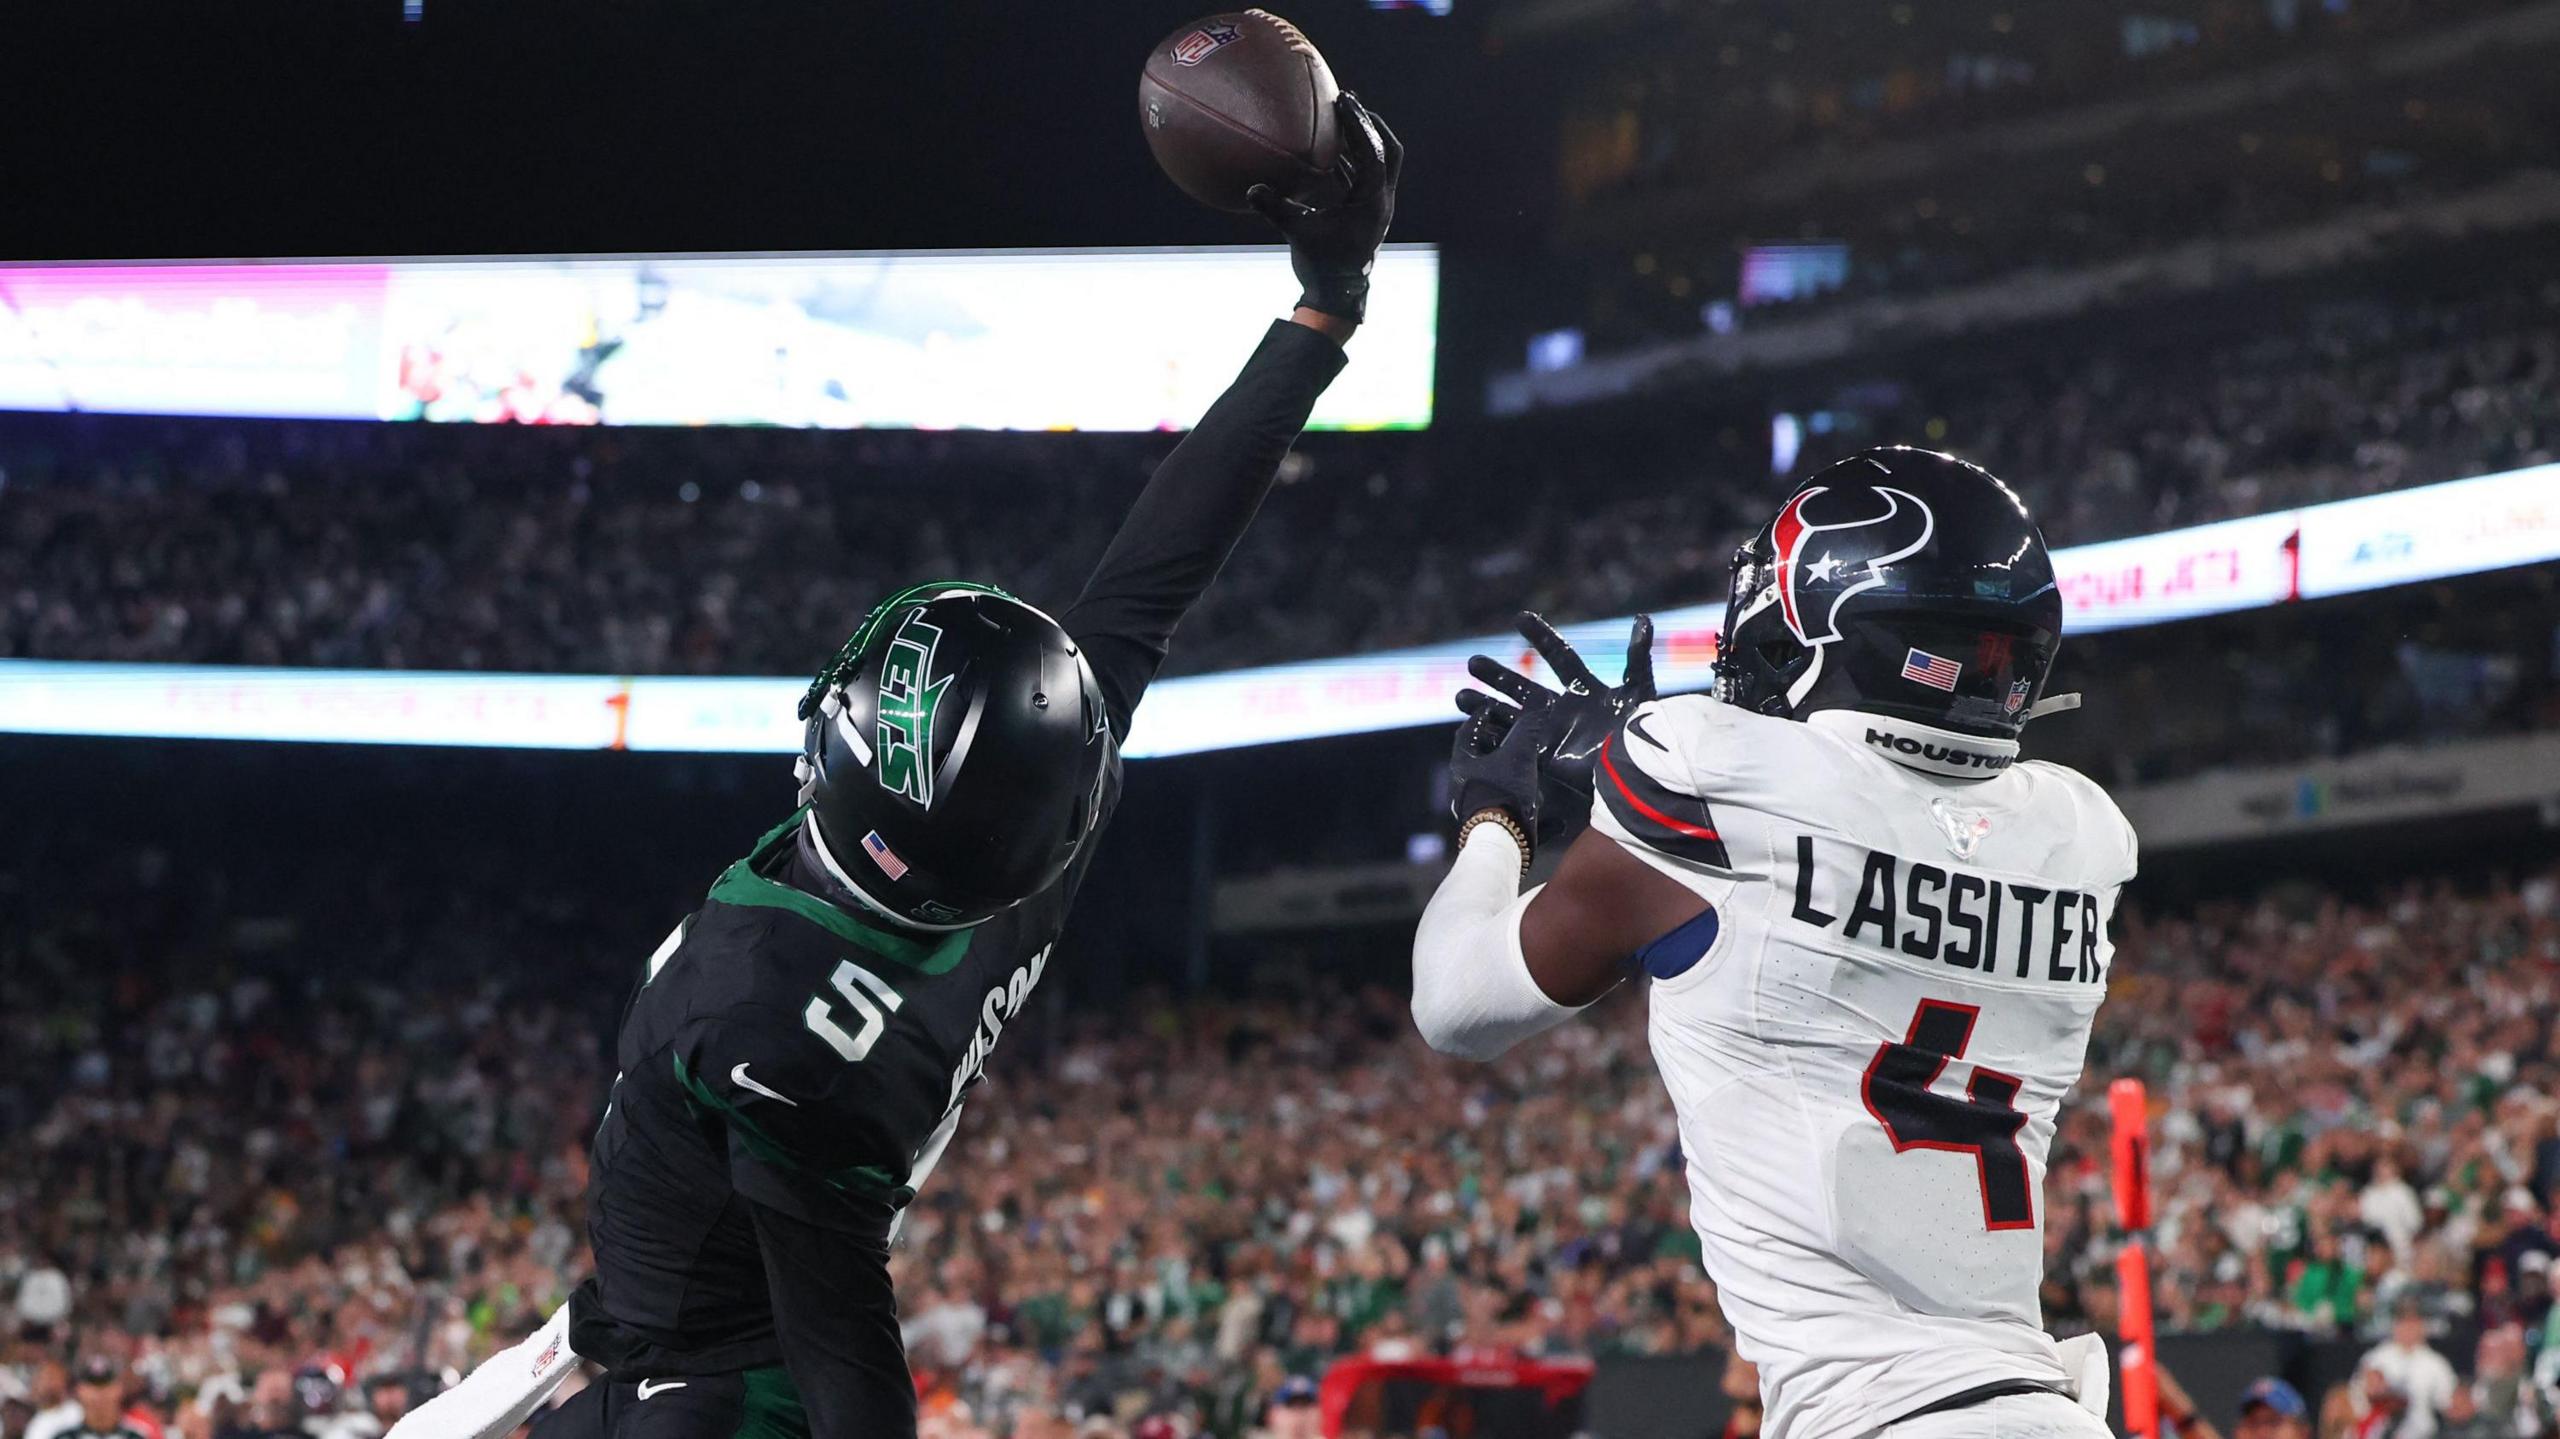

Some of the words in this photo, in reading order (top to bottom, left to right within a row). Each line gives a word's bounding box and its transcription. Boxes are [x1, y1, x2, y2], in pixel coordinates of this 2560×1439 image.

[1176, 31, 1214, 60] NFL
[876, 606, 954, 811] JETS
[1792, 836, 2101, 983] LASSITER
[804, 958, 904, 1063] 5
[1861, 997, 2035, 1232] 4
